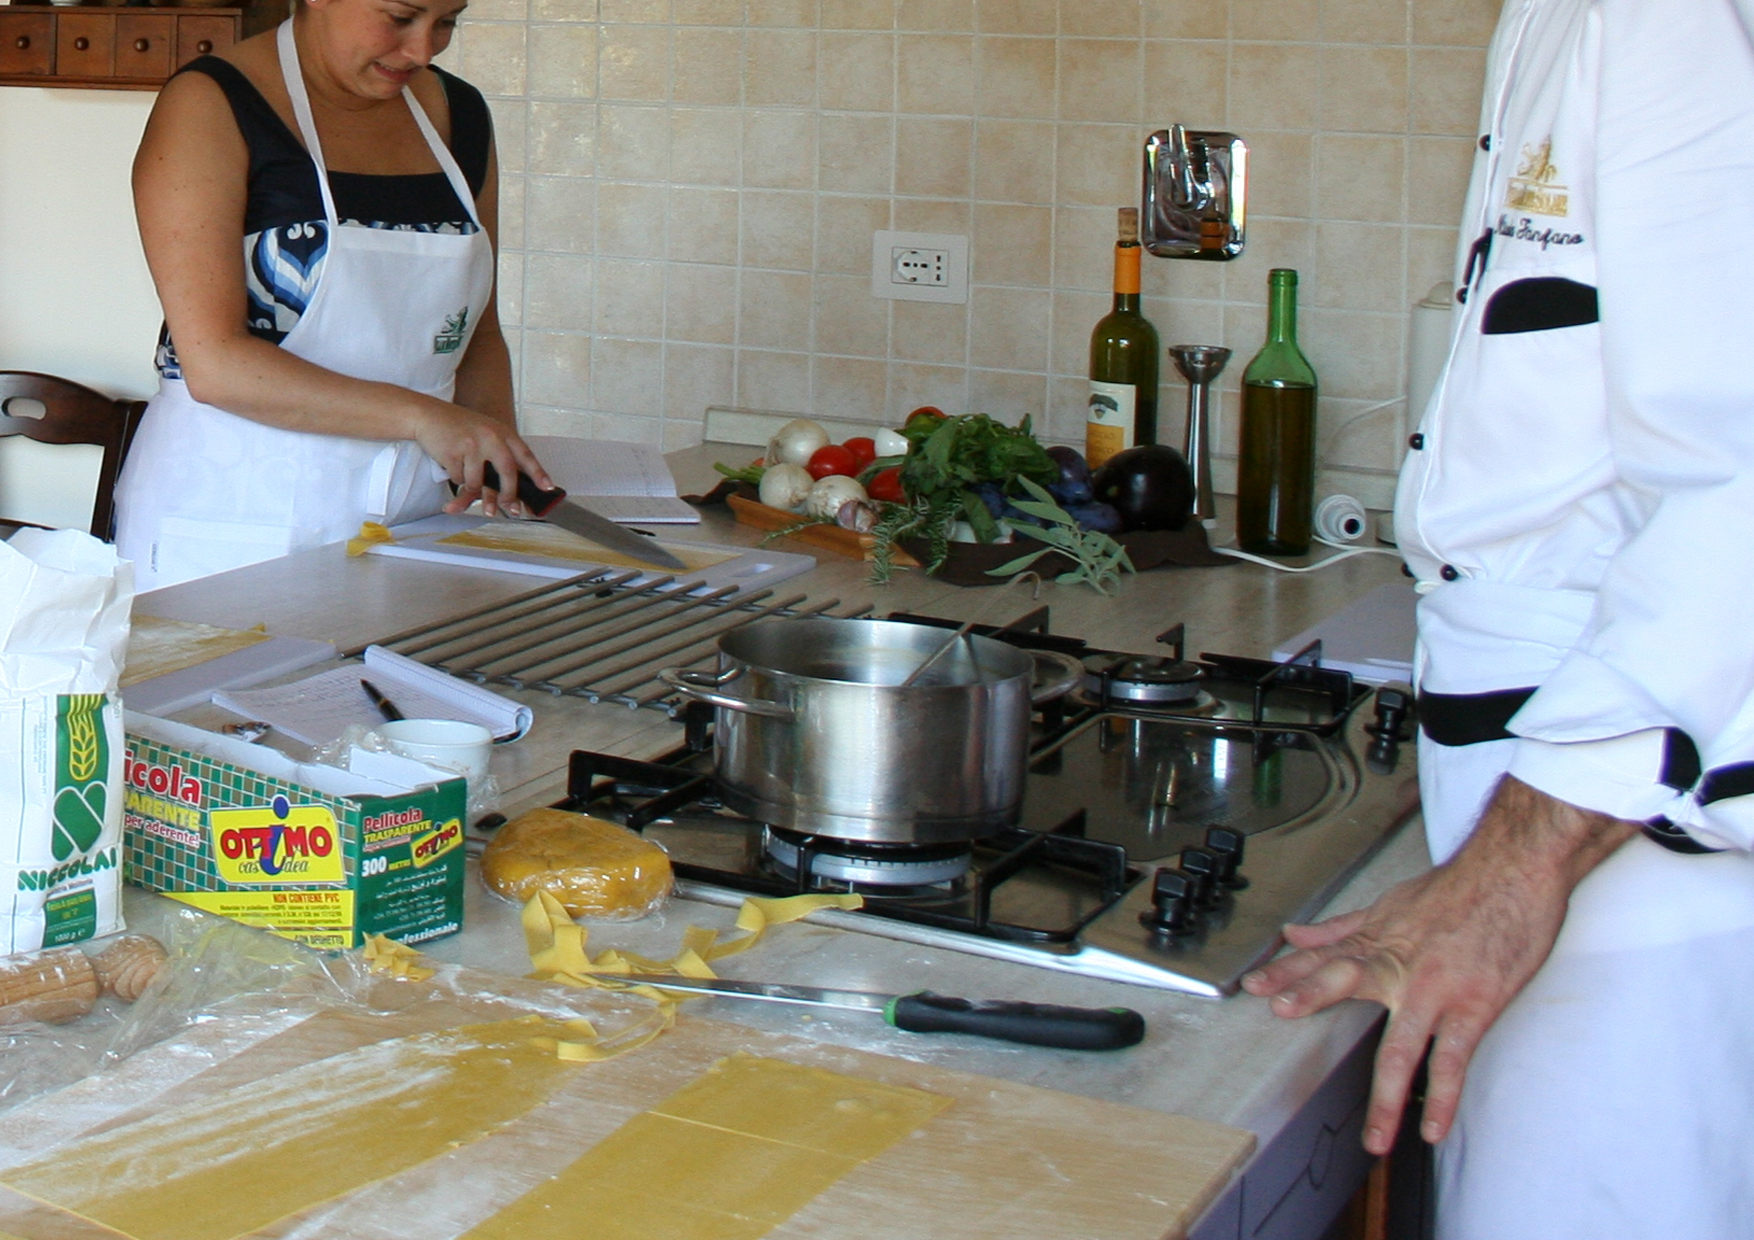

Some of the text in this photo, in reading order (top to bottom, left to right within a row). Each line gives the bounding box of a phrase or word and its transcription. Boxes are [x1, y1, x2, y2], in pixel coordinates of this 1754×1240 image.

[124, 788, 201, 831] ARENTE
[363, 806, 423, 833] Pellicola
[17, 846, 117, 891] NICCOLAI
[361, 855, 387, 878] 300
